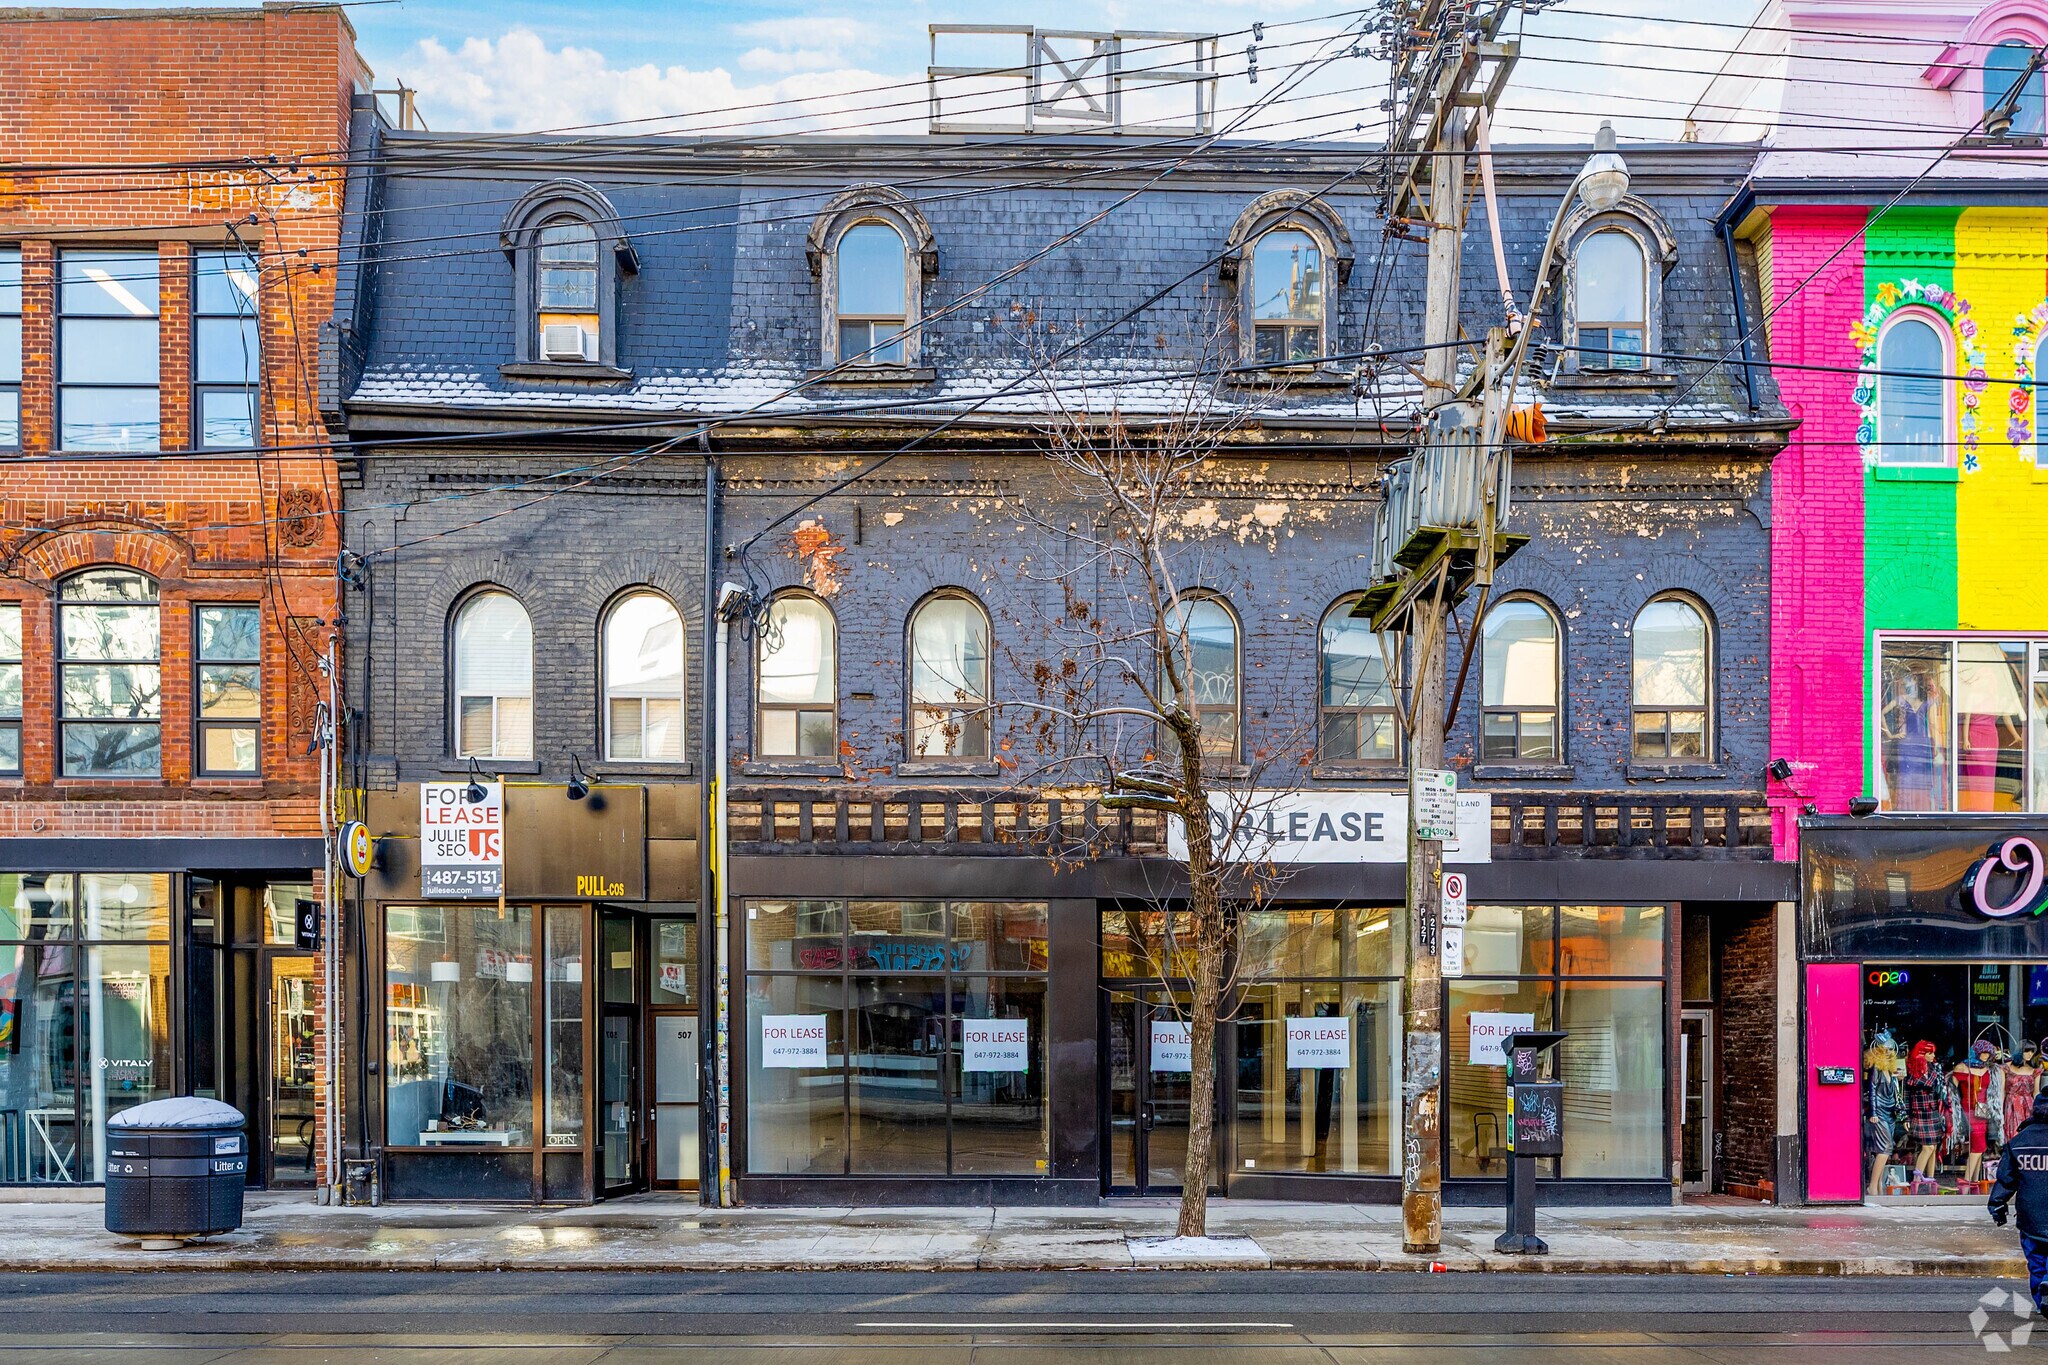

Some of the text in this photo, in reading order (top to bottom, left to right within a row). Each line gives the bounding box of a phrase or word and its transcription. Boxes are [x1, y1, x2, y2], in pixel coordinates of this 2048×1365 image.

[426, 807, 499, 824] LEASE
[1267, 812, 1384, 842] LEASE
[429, 829, 466, 842] JULIE
[437, 844, 466, 857] SEO
[431, 870, 497, 884] 487-5131
[427, 886, 472, 895] julieseo.com
[1868, 971, 1909, 987] open
[677, 1031, 692, 1039] 507
[764, 1027, 824, 1039] FOR LEASE
[1289, 1030, 1347, 1040] FOR LEASE
[1472, 1025, 1495, 1036] FOR
[966, 1032, 1025, 1043] FOR LEASE
[1153, 1033, 1175, 1044] FOR
[772, 1047, 818, 1055] 647-972-3884
[974, 1051, 1019, 1059] 647-972-3884
[1161, 1052, 1192, 1060] 647-972-
[111, 1059, 153, 1067] VITALY
[548, 1136, 575, 1145] OPEN
[214, 1160, 235, 1172] Litter
